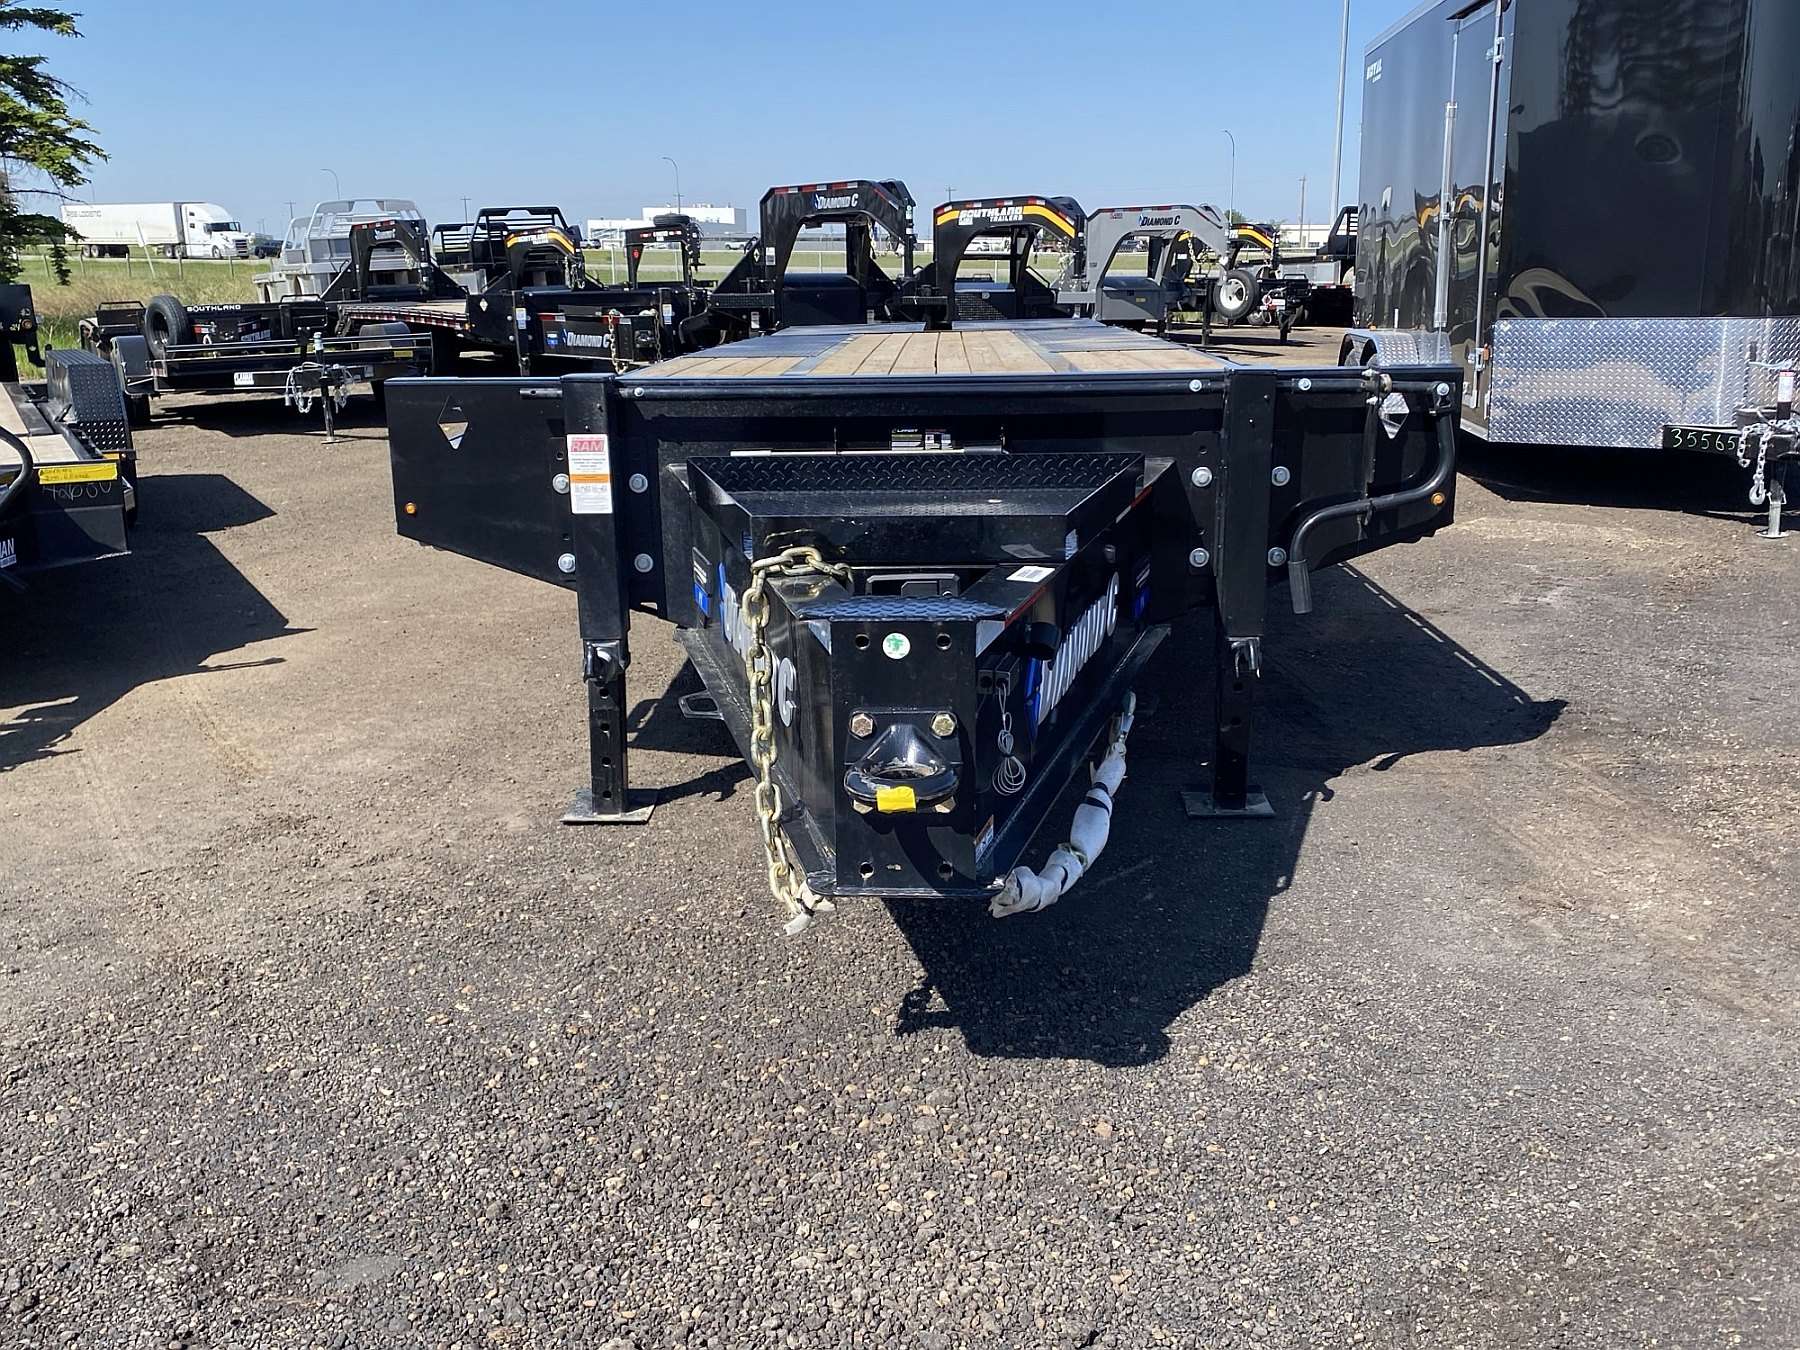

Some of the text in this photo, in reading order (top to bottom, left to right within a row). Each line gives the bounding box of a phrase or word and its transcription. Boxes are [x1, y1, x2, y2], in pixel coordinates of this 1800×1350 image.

[817, 193, 859, 210] DIAMOND C
[959, 205, 1023, 219] SOUTHLAND
[989, 214, 1023, 222] TRAILERS
[1140, 215, 1181, 227] DIAMOND C
[186, 304, 241, 313] SOUTHLAND
[567, 331, 610, 348] DIAMOND C
[571, 439, 604, 453] RAM
[1670, 428, 1738, 451] 35565
